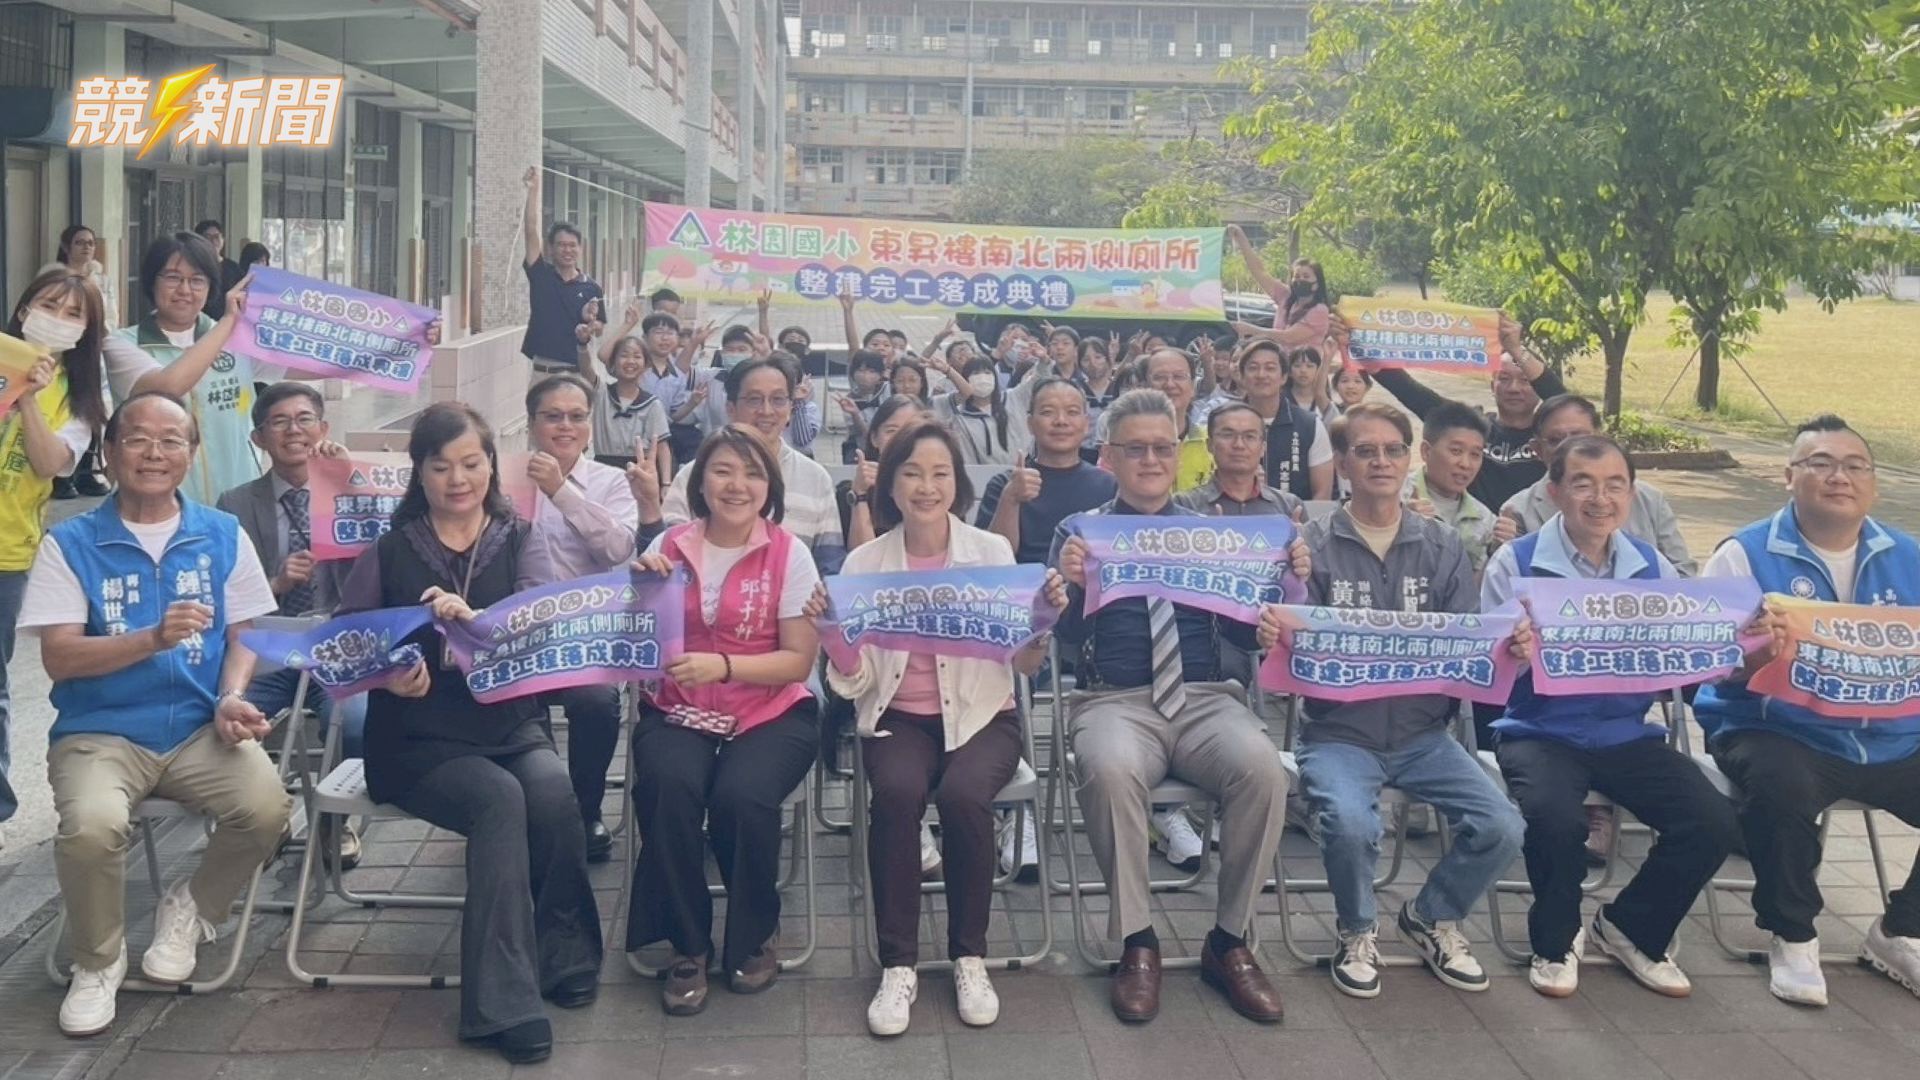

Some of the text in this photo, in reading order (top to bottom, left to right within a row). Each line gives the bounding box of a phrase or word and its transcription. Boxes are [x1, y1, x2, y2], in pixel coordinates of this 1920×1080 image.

[719, 219, 1202, 273] 林園國小 東昇樓南北兩側廁所
[798, 267, 1072, 308] 整建完工落成典禮
[301, 289, 393, 329] 林園國小
[1376, 308, 1456, 329] 林園國小
[255, 324, 416, 380] 整建工程落成典禮
[261, 306, 420, 358] 東昇樓南北兩側廁所
[1135, 526, 1247, 556] 林園國小
[507, 585, 615, 634] 林園國小
[1584, 593, 1698, 621] 林園國小
[1541, 622, 1737, 644] 東昇樓南北兩側廁所
[1831, 617, 1920, 650] 林園國
[467, 637, 659, 692] 整建工程落成典禮
[1290, 655, 1495, 687] 整建工程落成典禮
